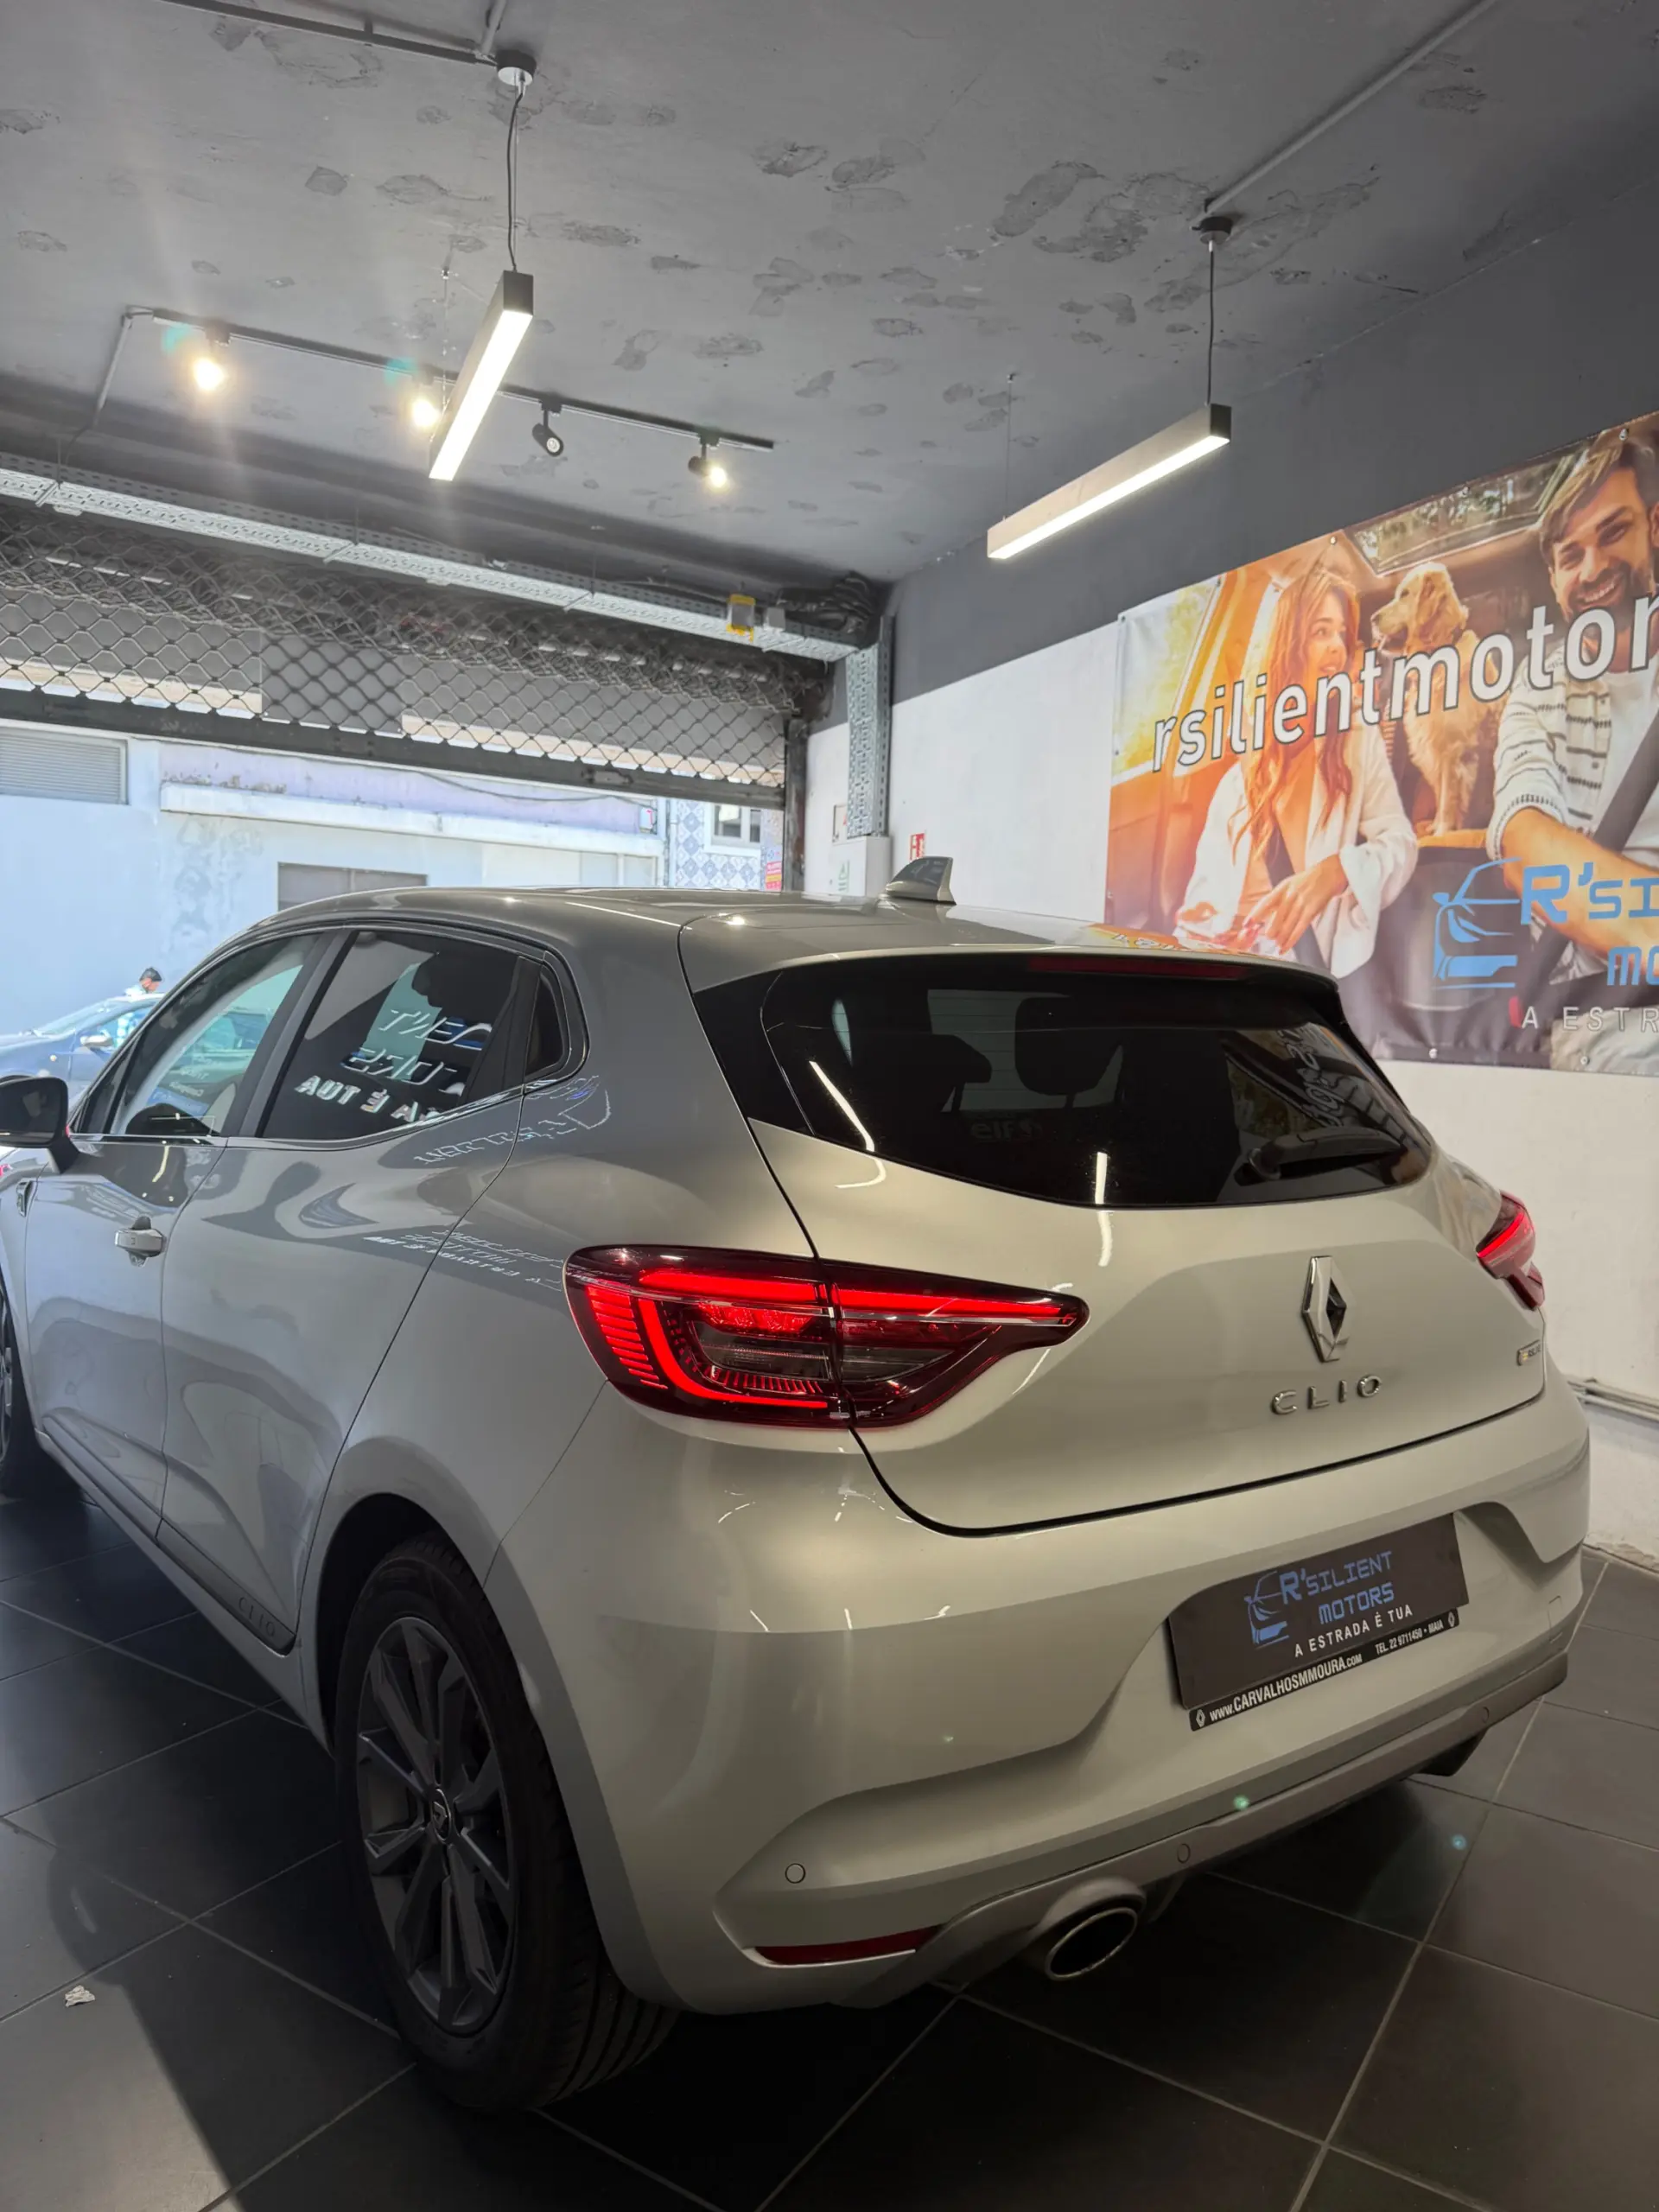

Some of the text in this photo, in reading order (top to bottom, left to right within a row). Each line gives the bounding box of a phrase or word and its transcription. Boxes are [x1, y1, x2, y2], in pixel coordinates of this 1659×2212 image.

[1522, 1005, 1659, 1033] A ESTR
[1271, 1375, 1382, 1415] CLIO
[1280, 1551, 1392, 1605] R'SILIENT
[1319, 1582, 1395, 1624] MOTORS
[1294, 1605, 1414, 1657] A ESTRADA É TUA
[1389, 1637, 1398, 1649] 22
[1427, 1619, 1444, 1634] MAIA
